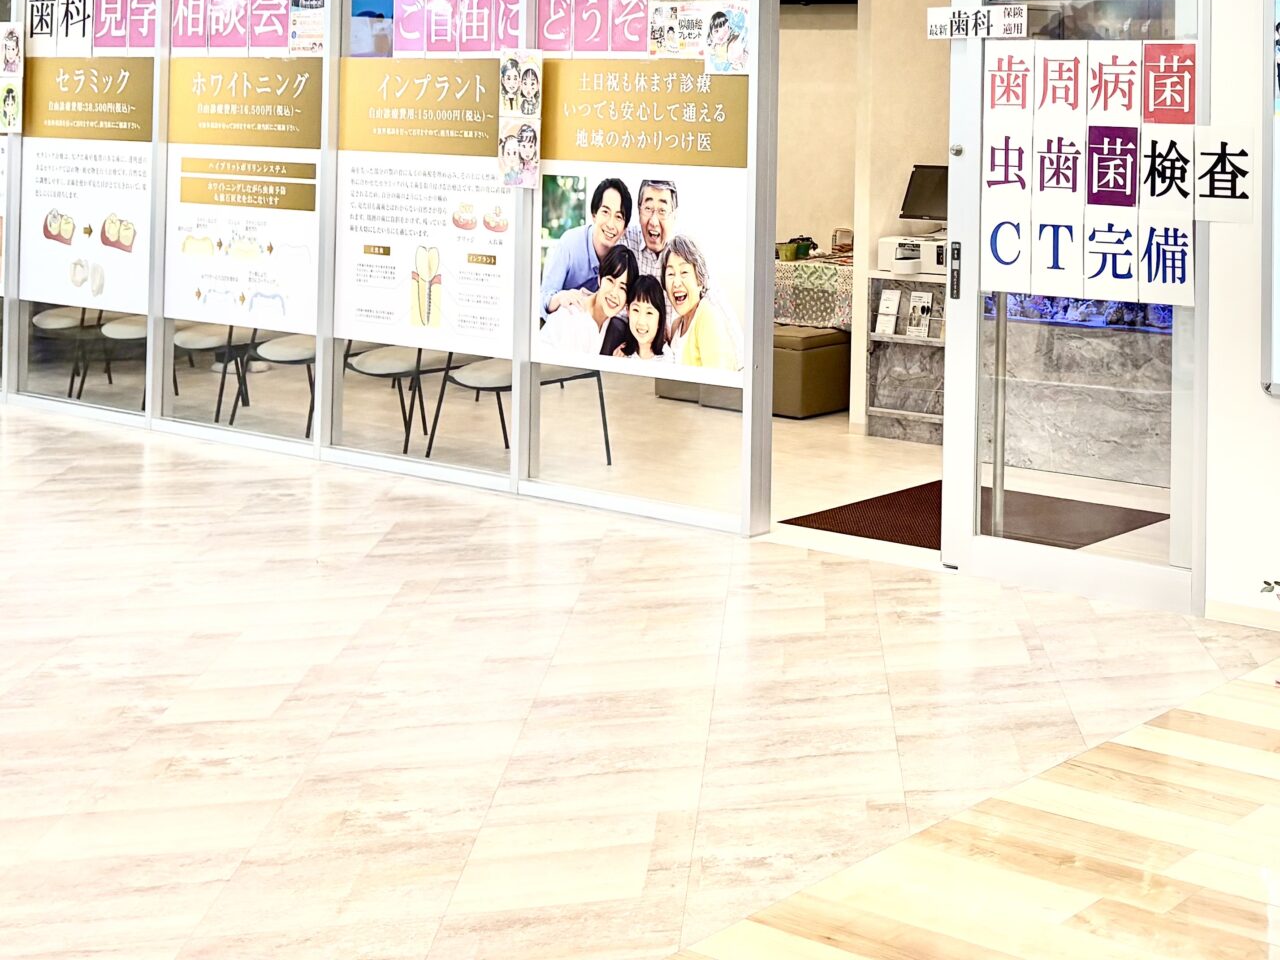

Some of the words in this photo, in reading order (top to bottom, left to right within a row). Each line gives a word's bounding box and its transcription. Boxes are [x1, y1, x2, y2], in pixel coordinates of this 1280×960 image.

[1003, 6, 1023, 19] 保険
[1003, 22, 1023, 35] 適用
[55, 68, 130, 95] セラミック
[191, 71, 310, 100] ホワイトニング
[378, 73, 487, 104] インプラント
[578, 72, 712, 96] 土日祝も休まず診療
[987, 54, 1192, 114] 歯周病菌
[563, 100, 726, 123] いつでも安心して通える
[575, 128, 712, 153] 地域のかかりつけ医
[986, 136, 1250, 200] 虫歯菌検査
